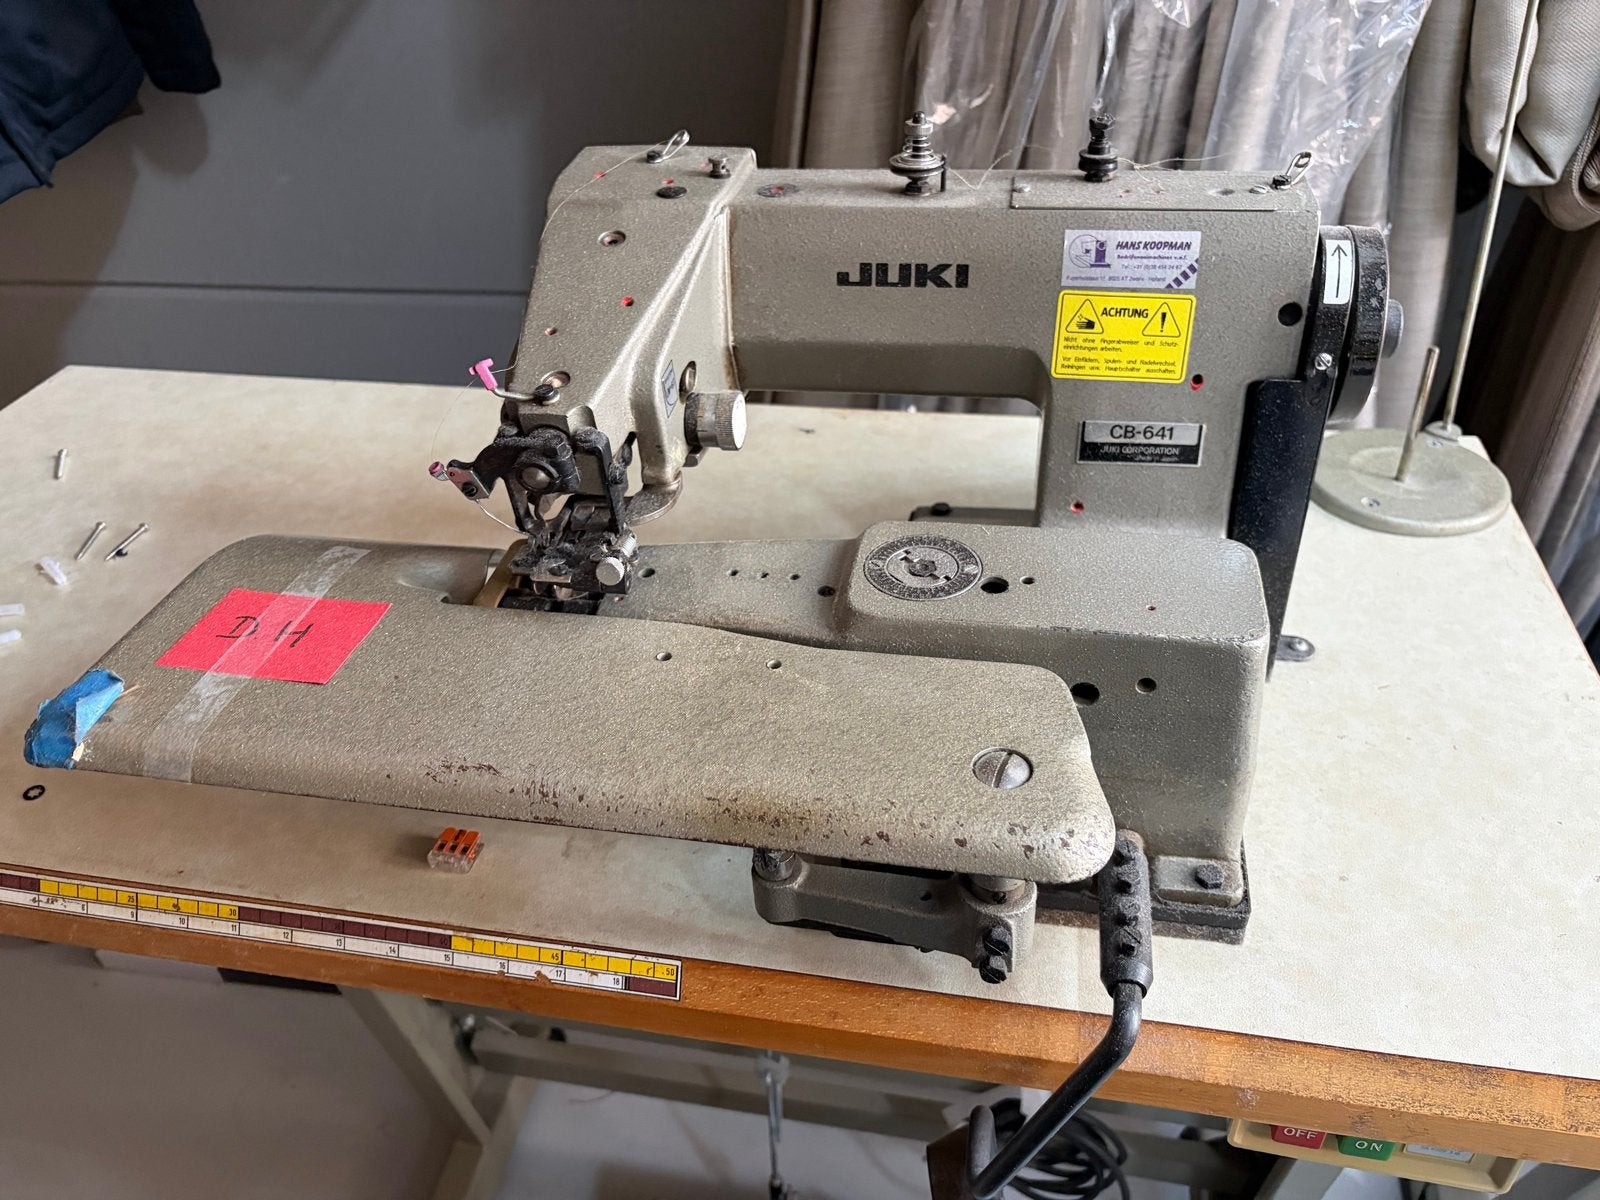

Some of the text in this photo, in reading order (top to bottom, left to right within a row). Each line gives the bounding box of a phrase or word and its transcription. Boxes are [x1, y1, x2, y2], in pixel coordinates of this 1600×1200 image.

[1116, 241, 1192, 251] HANS KOOPMAN
[837, 263, 969, 288] JUKI
[1101, 307, 1149, 318] ACHTUNG
[1063, 336, 1078, 344] Nicht
[1100, 337, 1140, 346] Fingerabweiser
[1159, 340, 1178, 348] Schutz-
[1063, 344, 1098, 353] einrichtungen
[1109, 424, 1174, 441] CB-641
[1100, 446, 1180, 456] JUKI CORPORATION
[130, 911, 135, 919] 9
[179, 917, 186, 925] 10
[231, 924, 237, 932] 11
[283, 931, 290, 939] 12
[336, 939, 343, 947] 13
[389, 946, 397, 954] 14
[444, 954, 451, 962] 15
[500, 961, 506, 969] 16
[556, 969, 563, 977] 17
[613, 977, 620, 985] 18
[229, 908, 237, 917] 30
[551, 953, 560, 961] 45
[666, 967, 675, 976] 50
[1283, 1127, 1318, 1140] OFF
[1355, 1140, 1384, 1152] ON
